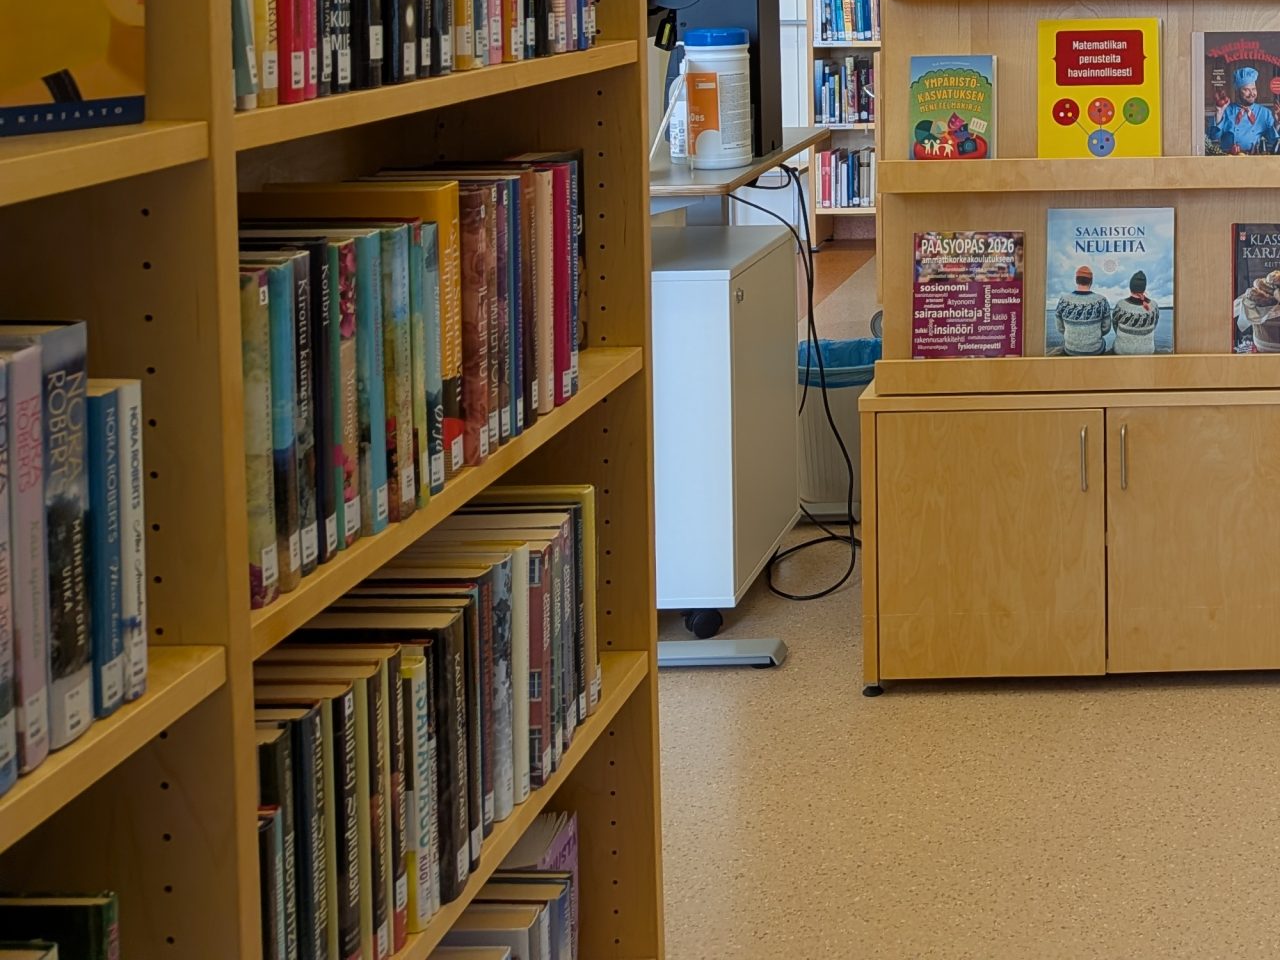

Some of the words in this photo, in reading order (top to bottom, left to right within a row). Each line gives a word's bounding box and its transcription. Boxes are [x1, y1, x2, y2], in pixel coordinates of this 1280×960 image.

[1072, 40, 1128, 50] Matematiikan
[1078, 55, 1121, 65] perusteita
[924, 73, 981, 88] YMPÄRISTÖ-
[1067, 67, 1133, 78] havainnollisesti
[917, 89, 985, 103] KASVATUKSEN
[1074, 225, 1146, 237] SAARISTON
[921, 236, 984, 254] PÄÄSYOPAS
[987, 238, 1015, 253] 2026
[1074, 239, 1146, 253] NEULEITA
[922, 255, 1015, 264] ammattikorkeakoulutukseen
[321, 264, 331, 327] Kolibri
[920, 283, 969, 292] sosionomi
[984, 284, 992, 323] tradenomi
[992, 296, 1021, 304] muusikko
[298, 278, 311, 345] Kirottu
[914, 307, 983, 323] sairaanhoitaja
[934, 323, 974, 335] insinööri
[957, 341, 1002, 351] fysioterapeutti
[299, 350, 311, 419] kauneus
[47, 370, 68, 498] ROBERTS
[64, 370, 86, 482] NORA
[106, 407, 118, 462] NORA
[17, 399, 30, 495] ROBERTS
[30, 395, 42, 490] NORA
[130, 448, 142, 511] ROBERTS
[107, 462, 119, 544] ROBERTS
[62, 565, 73, 614] UHKA
[72, 519, 86, 648] MENNEISYYDEN
